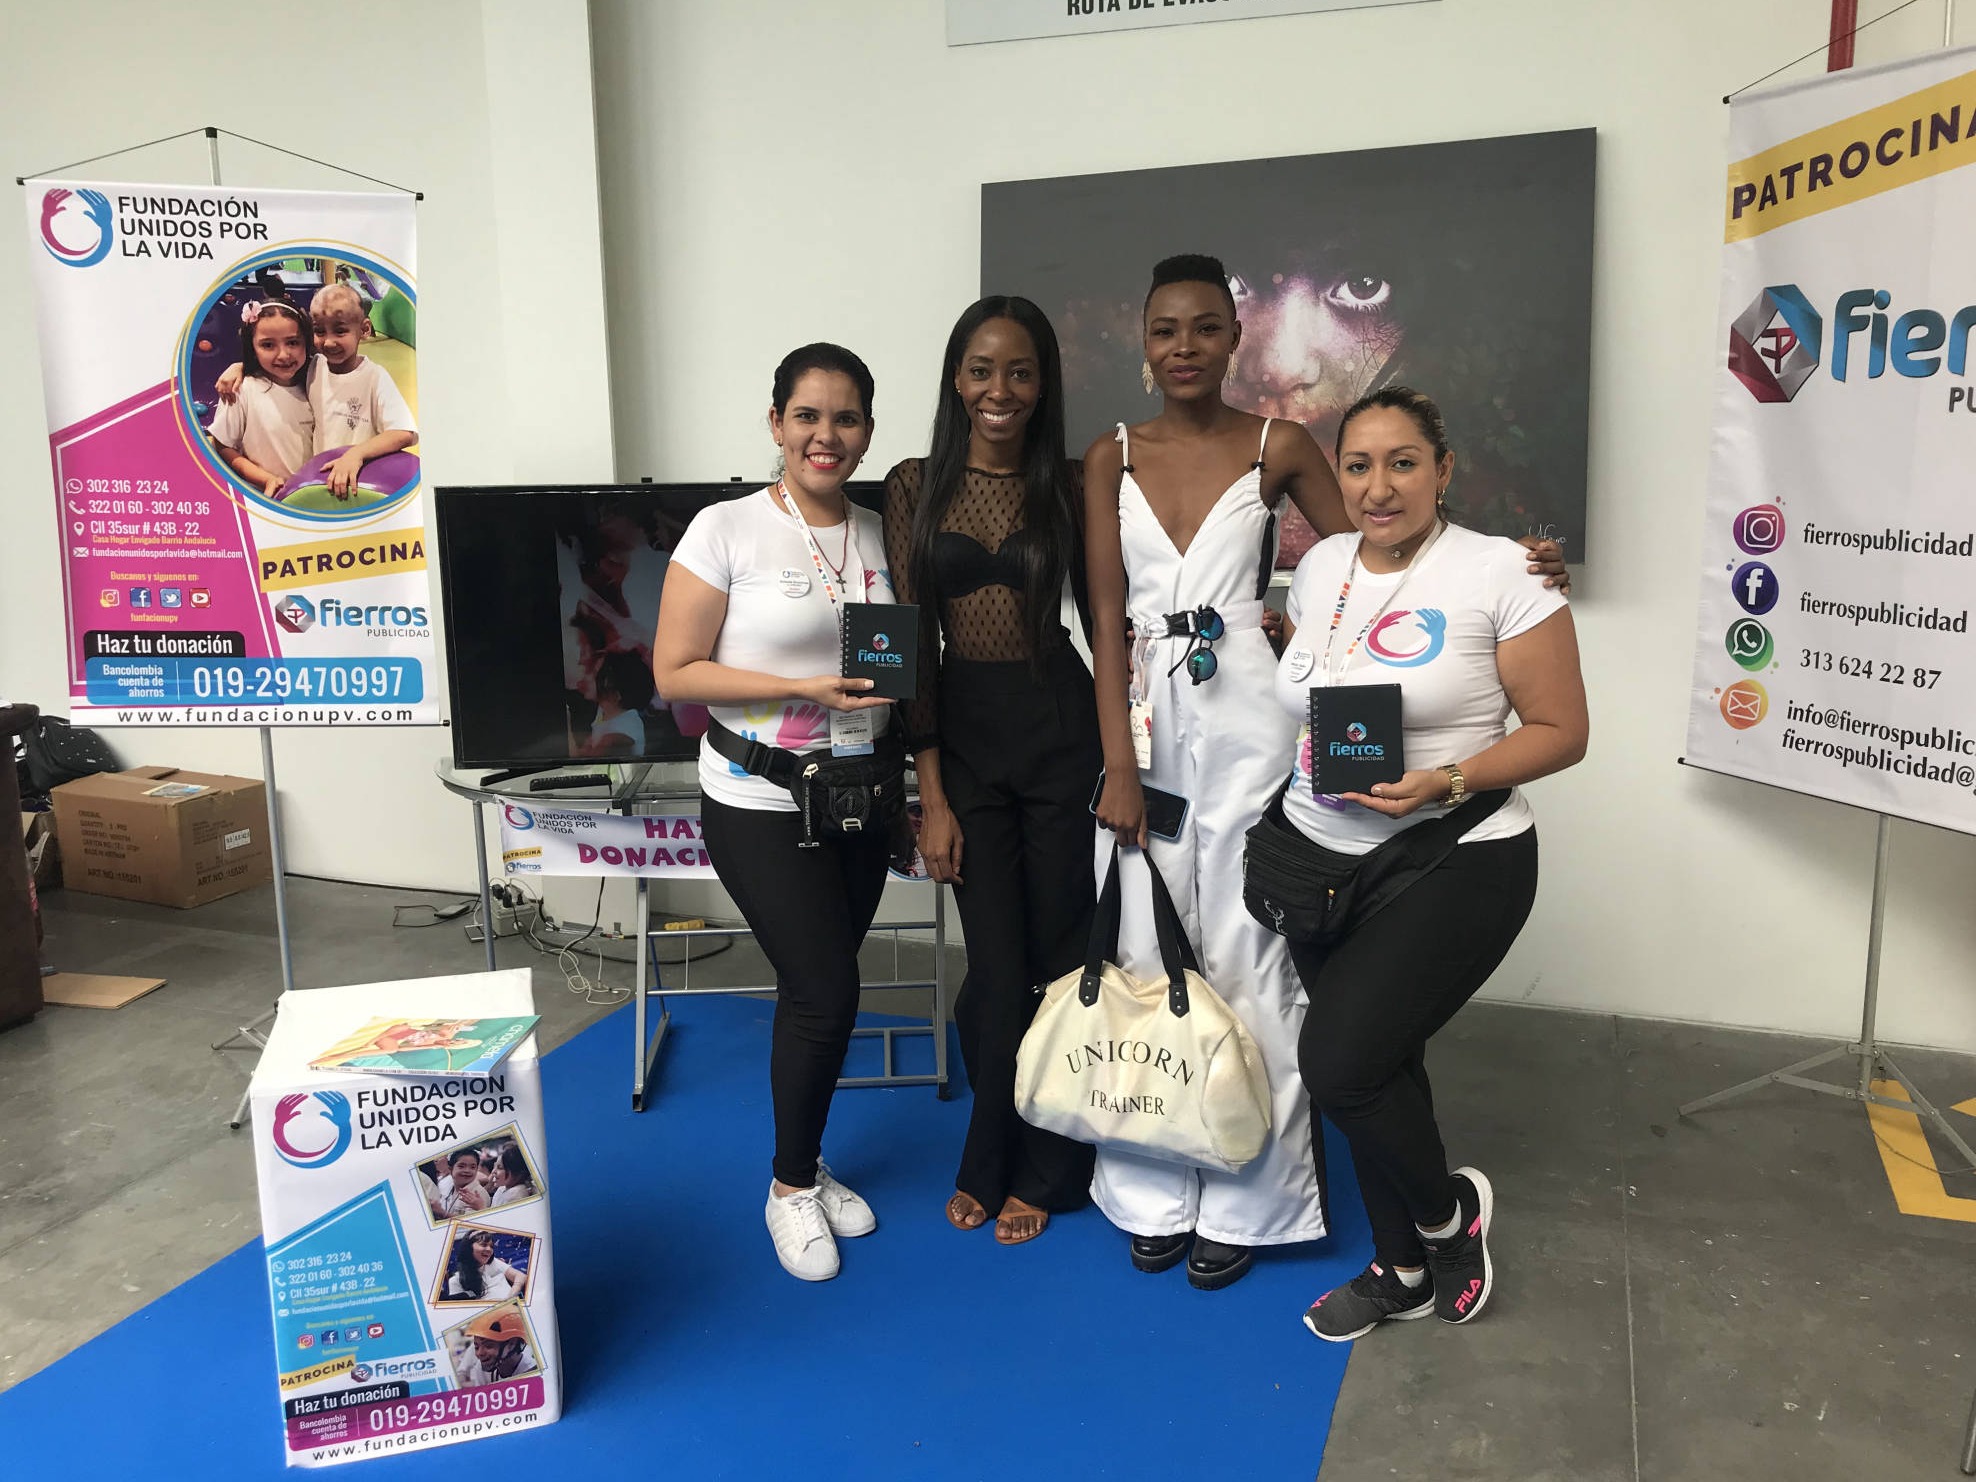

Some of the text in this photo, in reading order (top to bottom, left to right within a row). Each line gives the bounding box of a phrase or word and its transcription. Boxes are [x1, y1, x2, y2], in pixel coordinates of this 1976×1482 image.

[118, 195, 259, 219] FUNDACIÓN
[120, 218, 268, 241] UNIDOS POR
[122, 240, 214, 260] LA VIDA
[86, 479, 169, 494] 302 316 23 24
[88, 500, 110, 514] 322
[113, 500, 125, 514] 01
[128, 501, 143, 515] 60
[151, 501, 174, 515] 302
[177, 501, 192, 515] 40
[195, 501, 210, 515] 36
[108, 521, 140, 535] 35sur
[153, 521, 176, 535] 43B
[184, 522, 199, 535] 22
[1803, 522, 1974, 557] fierrospublicidad
[263, 541, 425, 580] PATROCINA
[320, 598, 428, 627] fierros
[1800, 591, 1968, 633] fierrospublicidad
[97, 633, 233, 654] Haz tu donación
[367, 628, 430, 638] PUBLICIDAD
[858, 649, 903, 665] fierros
[103, 664, 163, 676] Bancolombia
[1800, 648, 1942, 690] 313 624 22 87
[118, 676, 164, 687] cuenta de
[128, 687, 165, 698] ahorros
[193, 666, 403, 698] 019-29470997
[118, 707, 413, 725] www.fundacionupv.com
[1787, 699, 1976, 756] info@fierrospublic
[1329, 741, 1384, 757] fierros
[1782, 728, 1976, 796] fierrospublicidad@
[534, 818, 597, 829] UNIDOS POR
[551, 826, 574, 834] VIDA
[643, 818, 704, 840] HA
[1066, 1040, 1195, 1087] UNICORN
[359, 1095, 515, 1130] UNIDOS POR
[1089, 1089, 1165, 1116] TRAINER
[360, 1123, 457, 1150] LA VIDA
[287, 1251, 352, 1271] 302 316 23 24
[288, 1273, 307, 1285] 322
[308, 1271, 318, 1282] 01
[319, 1269, 332, 1281] 60
[338, 1265, 356, 1278] 302
[357, 1262, 370, 1274] 40
[372, 1261, 384, 1272] 36
[363, 1276, 376, 1288] 22
[1455, 1279, 1481, 1313] FILA
[280, 1359, 355, 1387] PATROCINA
[375, 1358, 437, 1377] fierros
[294, 1384, 401, 1414] Haz tu donación
[369, 1384, 530, 1432] 019-29470997
[299, 1413, 347, 1430] Bancolombia
[313, 1411, 539, 1462] www.fundacionupv.com
